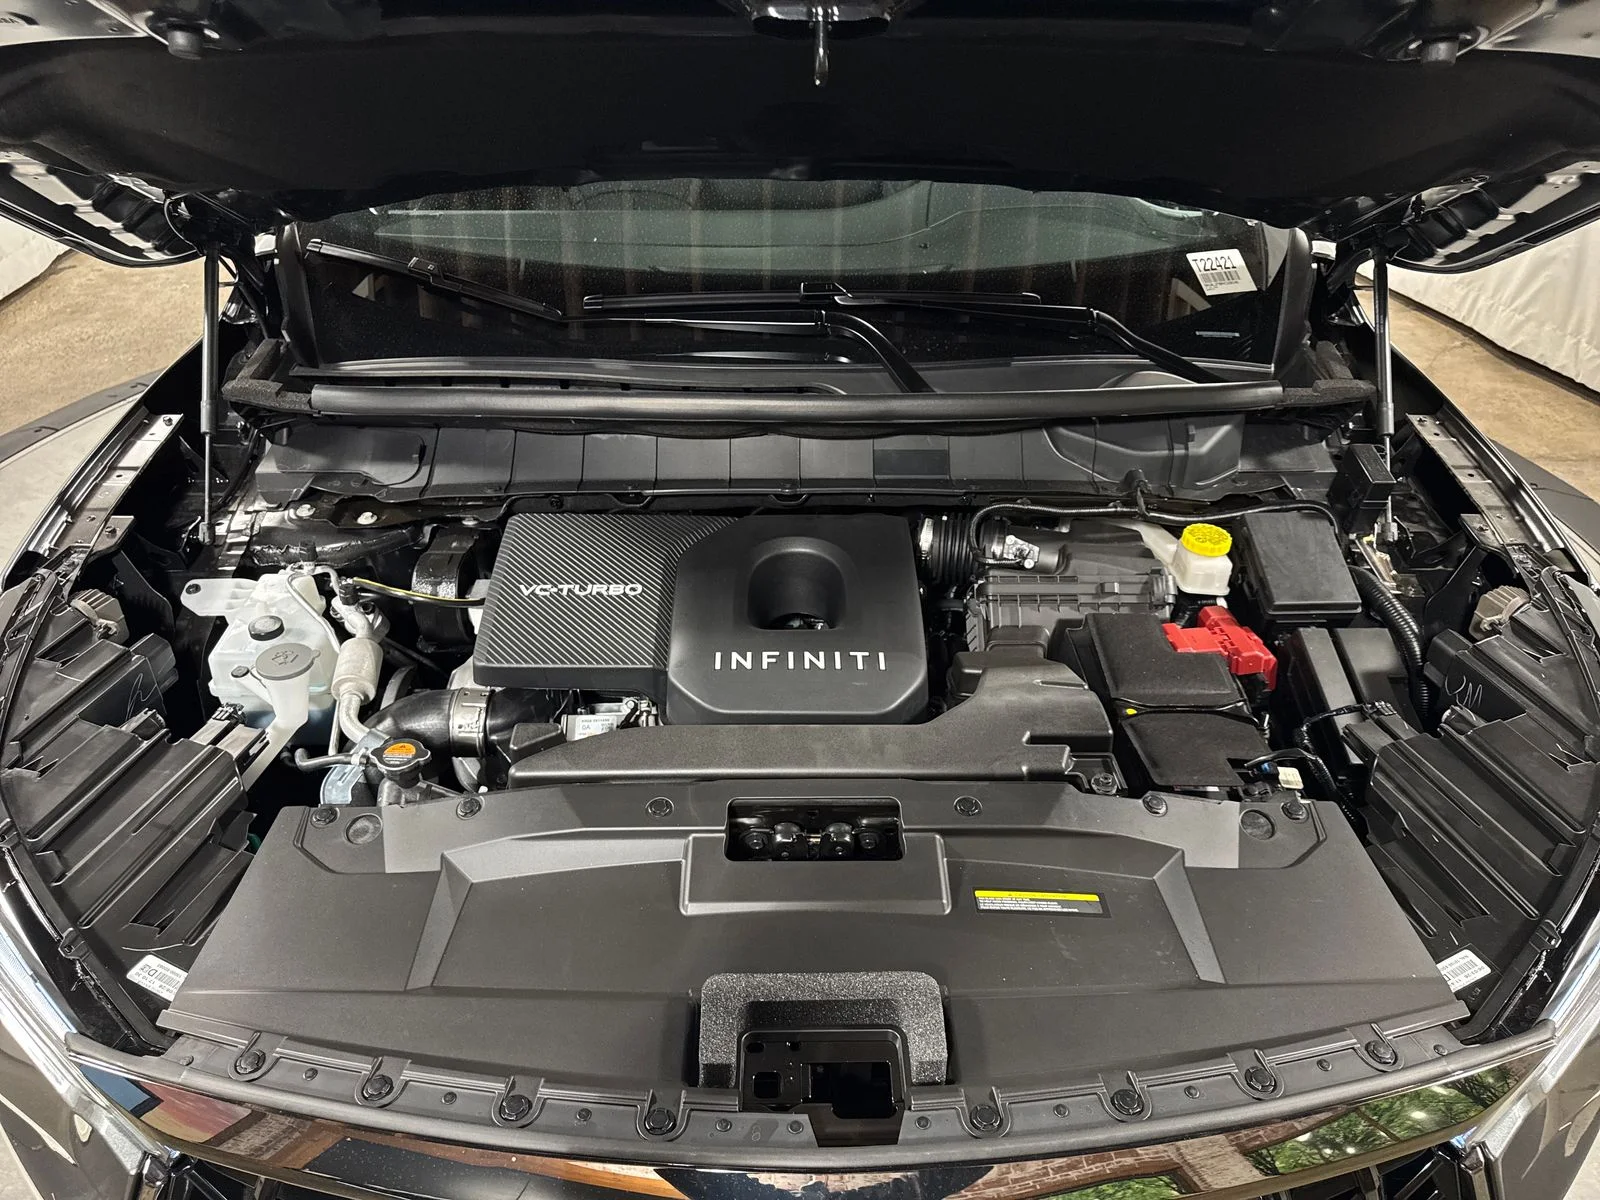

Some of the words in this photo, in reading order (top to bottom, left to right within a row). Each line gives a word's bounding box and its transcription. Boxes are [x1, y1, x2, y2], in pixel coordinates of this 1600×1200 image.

[1192, 256, 1237, 272] T22421
[519, 584, 643, 596] VC-TURBO
[714, 651, 886, 670] INFINITI
